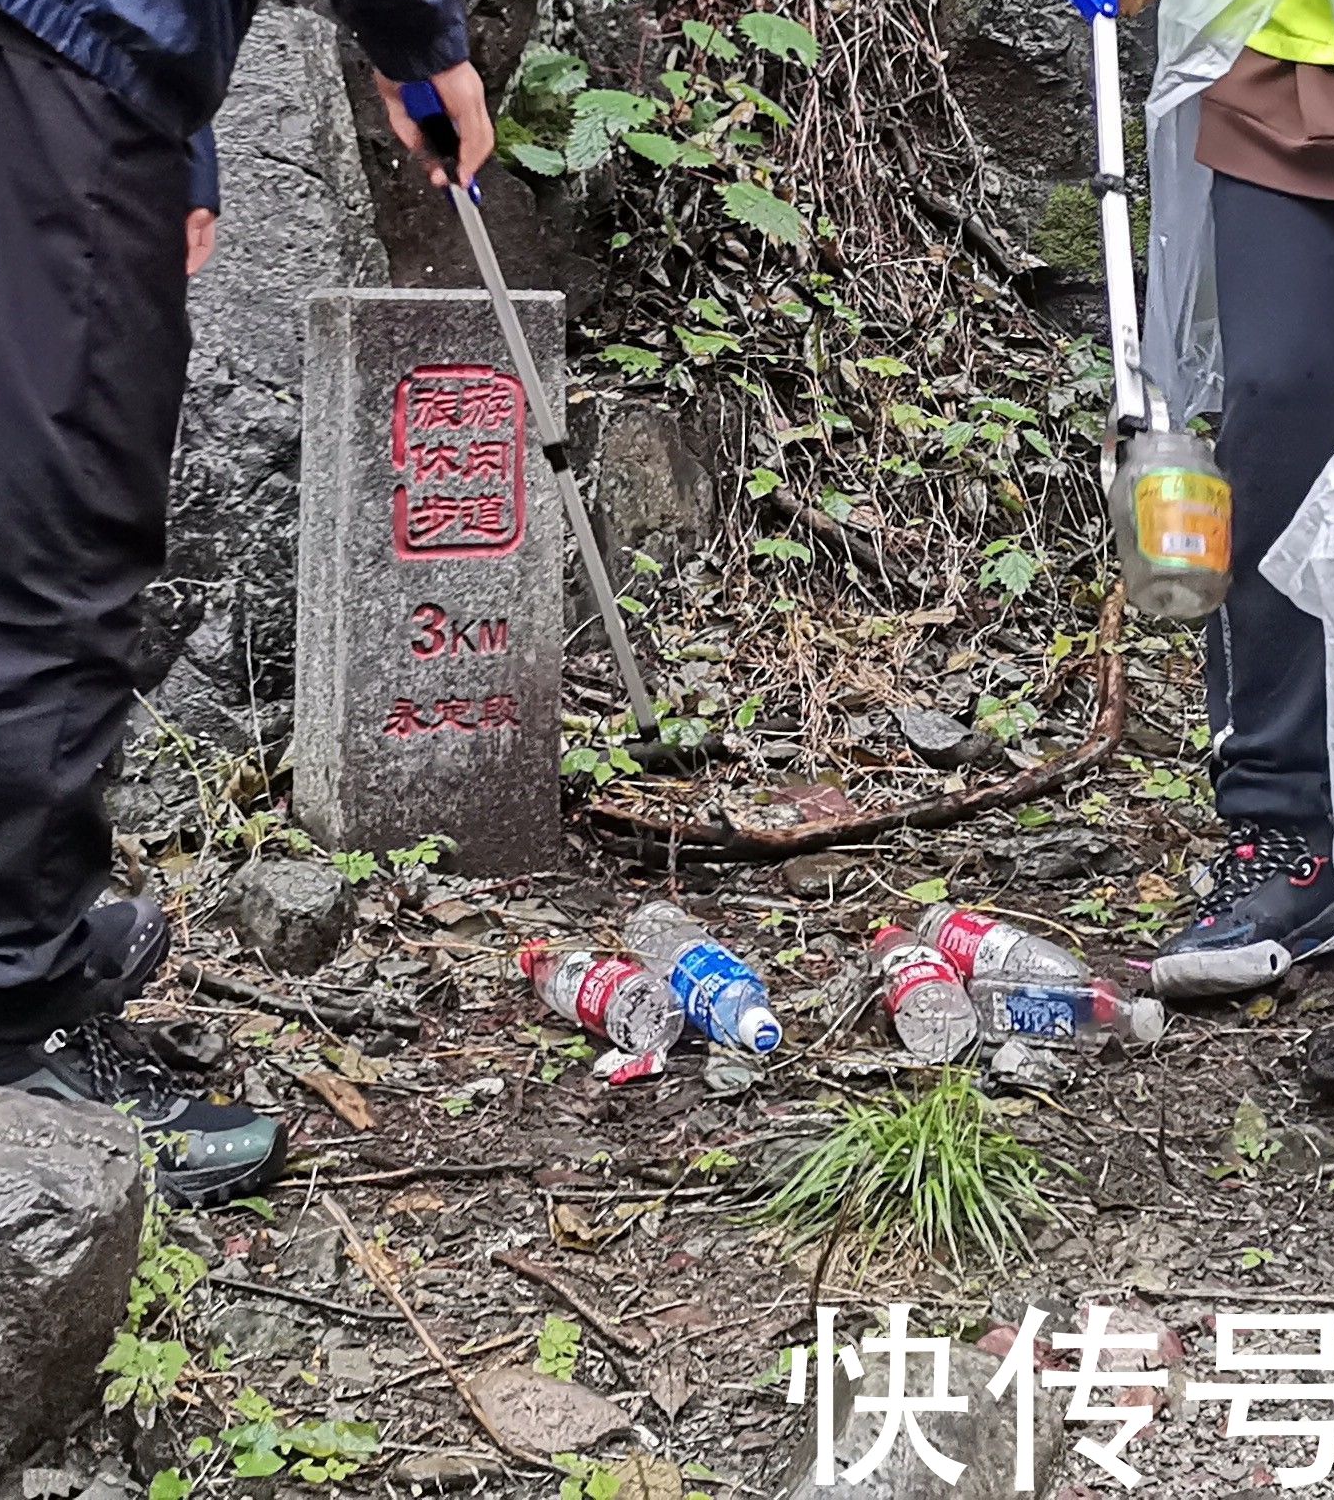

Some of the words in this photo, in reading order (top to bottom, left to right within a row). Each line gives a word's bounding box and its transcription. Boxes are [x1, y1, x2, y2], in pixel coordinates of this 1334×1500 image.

[411, 384, 516, 430] 旅游
[409, 439, 511, 485] 休闲
[408, 492, 510, 546] 步道
[410, 602, 509, 661] 3KM
[381, 694, 523, 740] 永定段
